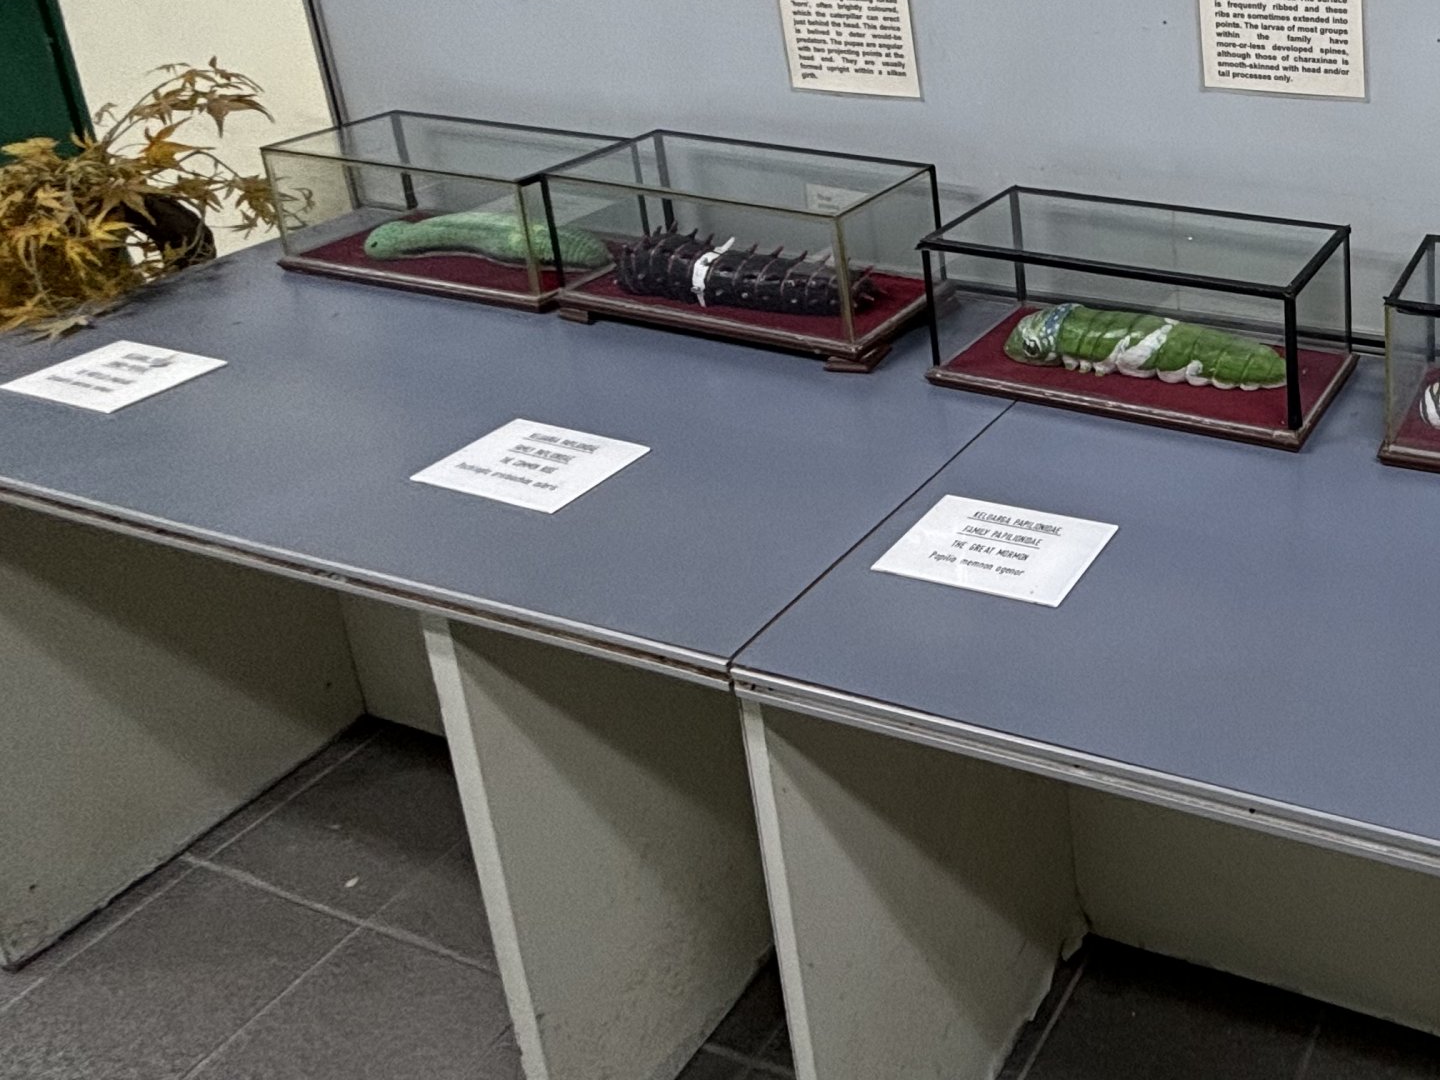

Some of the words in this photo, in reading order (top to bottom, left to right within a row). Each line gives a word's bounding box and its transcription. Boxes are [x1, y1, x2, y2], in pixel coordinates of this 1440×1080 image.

[962, 525, 989, 536] FAMILY
[951, 540, 967, 549] THE
[969, 543, 995, 553] GREAT
